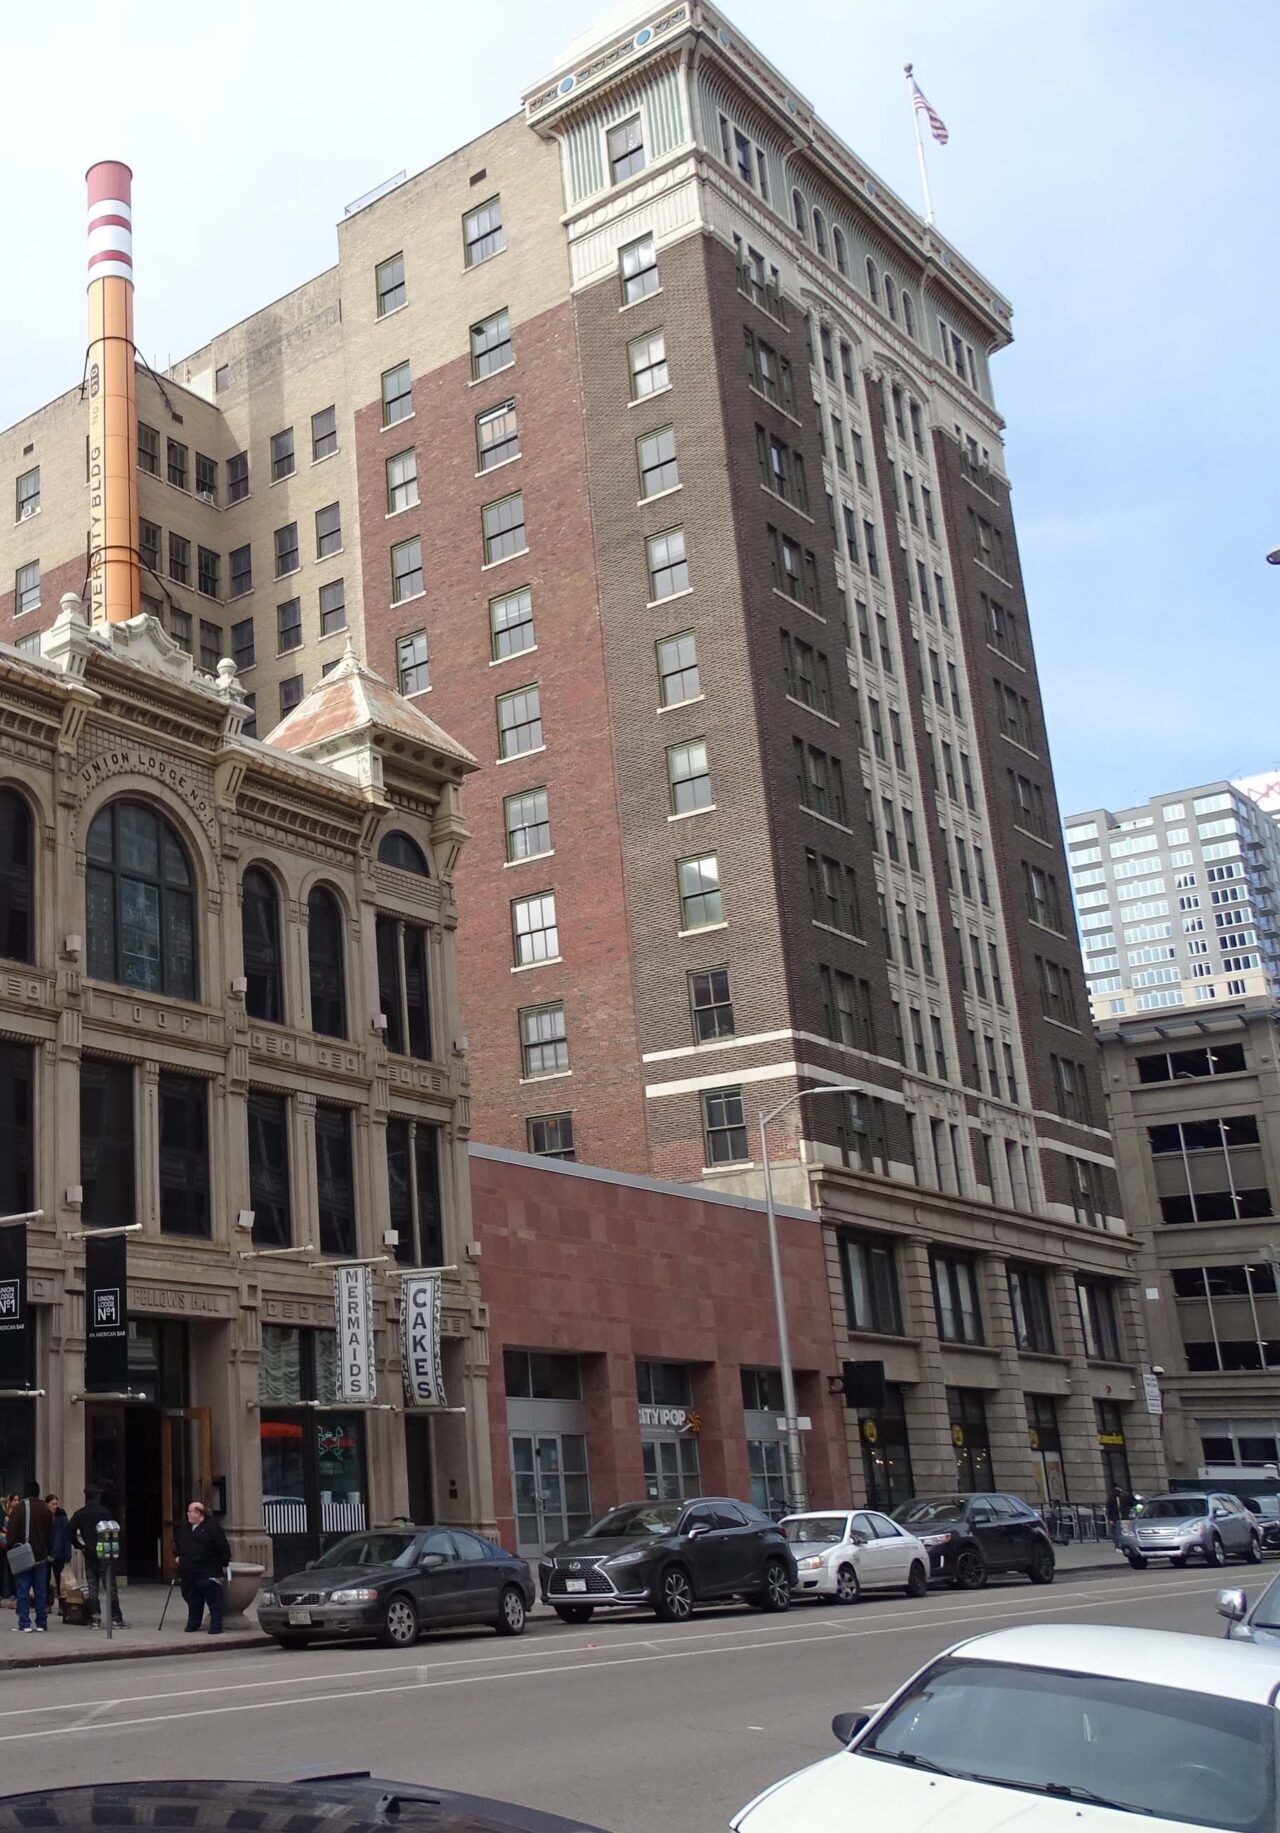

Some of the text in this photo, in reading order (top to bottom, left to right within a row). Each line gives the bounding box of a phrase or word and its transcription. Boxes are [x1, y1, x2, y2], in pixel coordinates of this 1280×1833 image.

[91, 446, 102, 507] BLDG
[91, 516, 103, 620] IVERSITY
[81, 752, 130, 782] UNION
[138, 753, 187, 789] LODGE
[191, 1293, 220, 1312] HALL
[345, 1270, 362, 1393] MERMAIDS
[412, 1288, 432, 1399] CAKES
